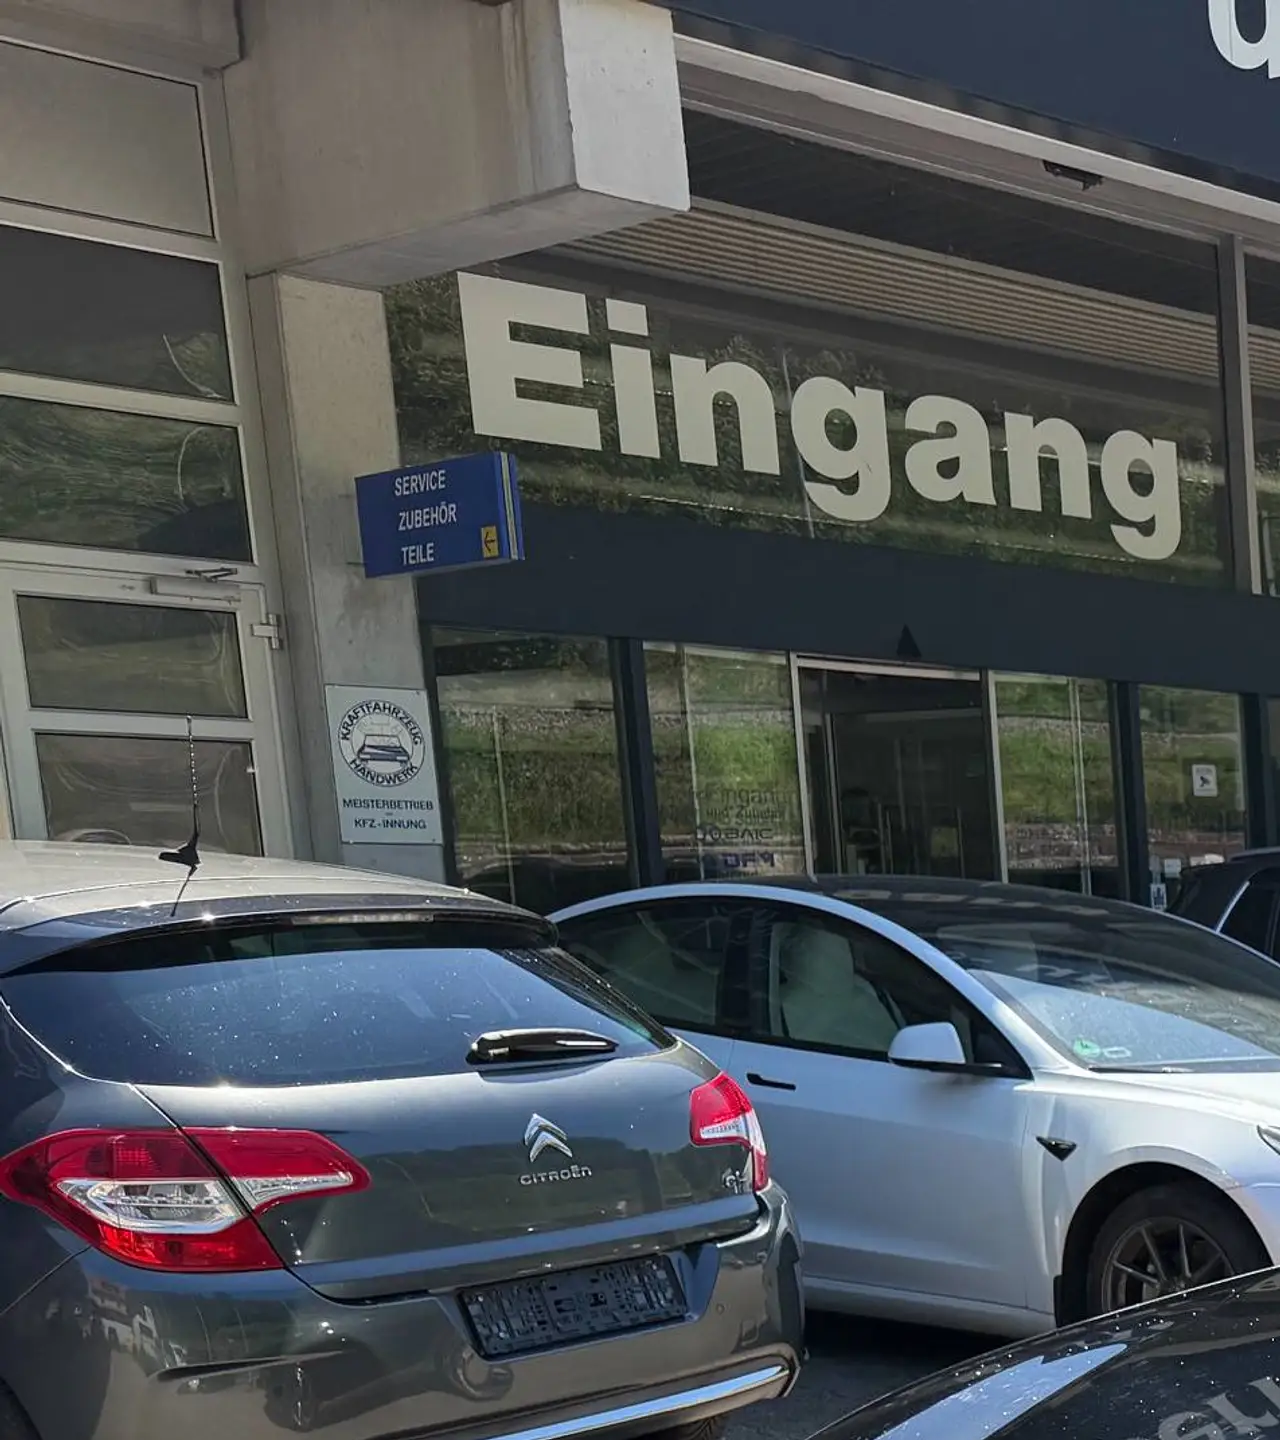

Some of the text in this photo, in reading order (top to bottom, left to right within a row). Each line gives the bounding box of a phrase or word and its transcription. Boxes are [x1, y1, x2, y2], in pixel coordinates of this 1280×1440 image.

[457, 271, 1182, 560] Eingang
[394, 470, 446, 497] SERVICE
[398, 501, 457, 531] ZUBEHÖR
[401, 542, 434, 566] TEILE
[340, 701, 422, 746] KRAFTFAHRZEUG
[350, 758, 418, 785] HANDWERK
[343, 798, 433, 811] MEISTERBETRIEB
